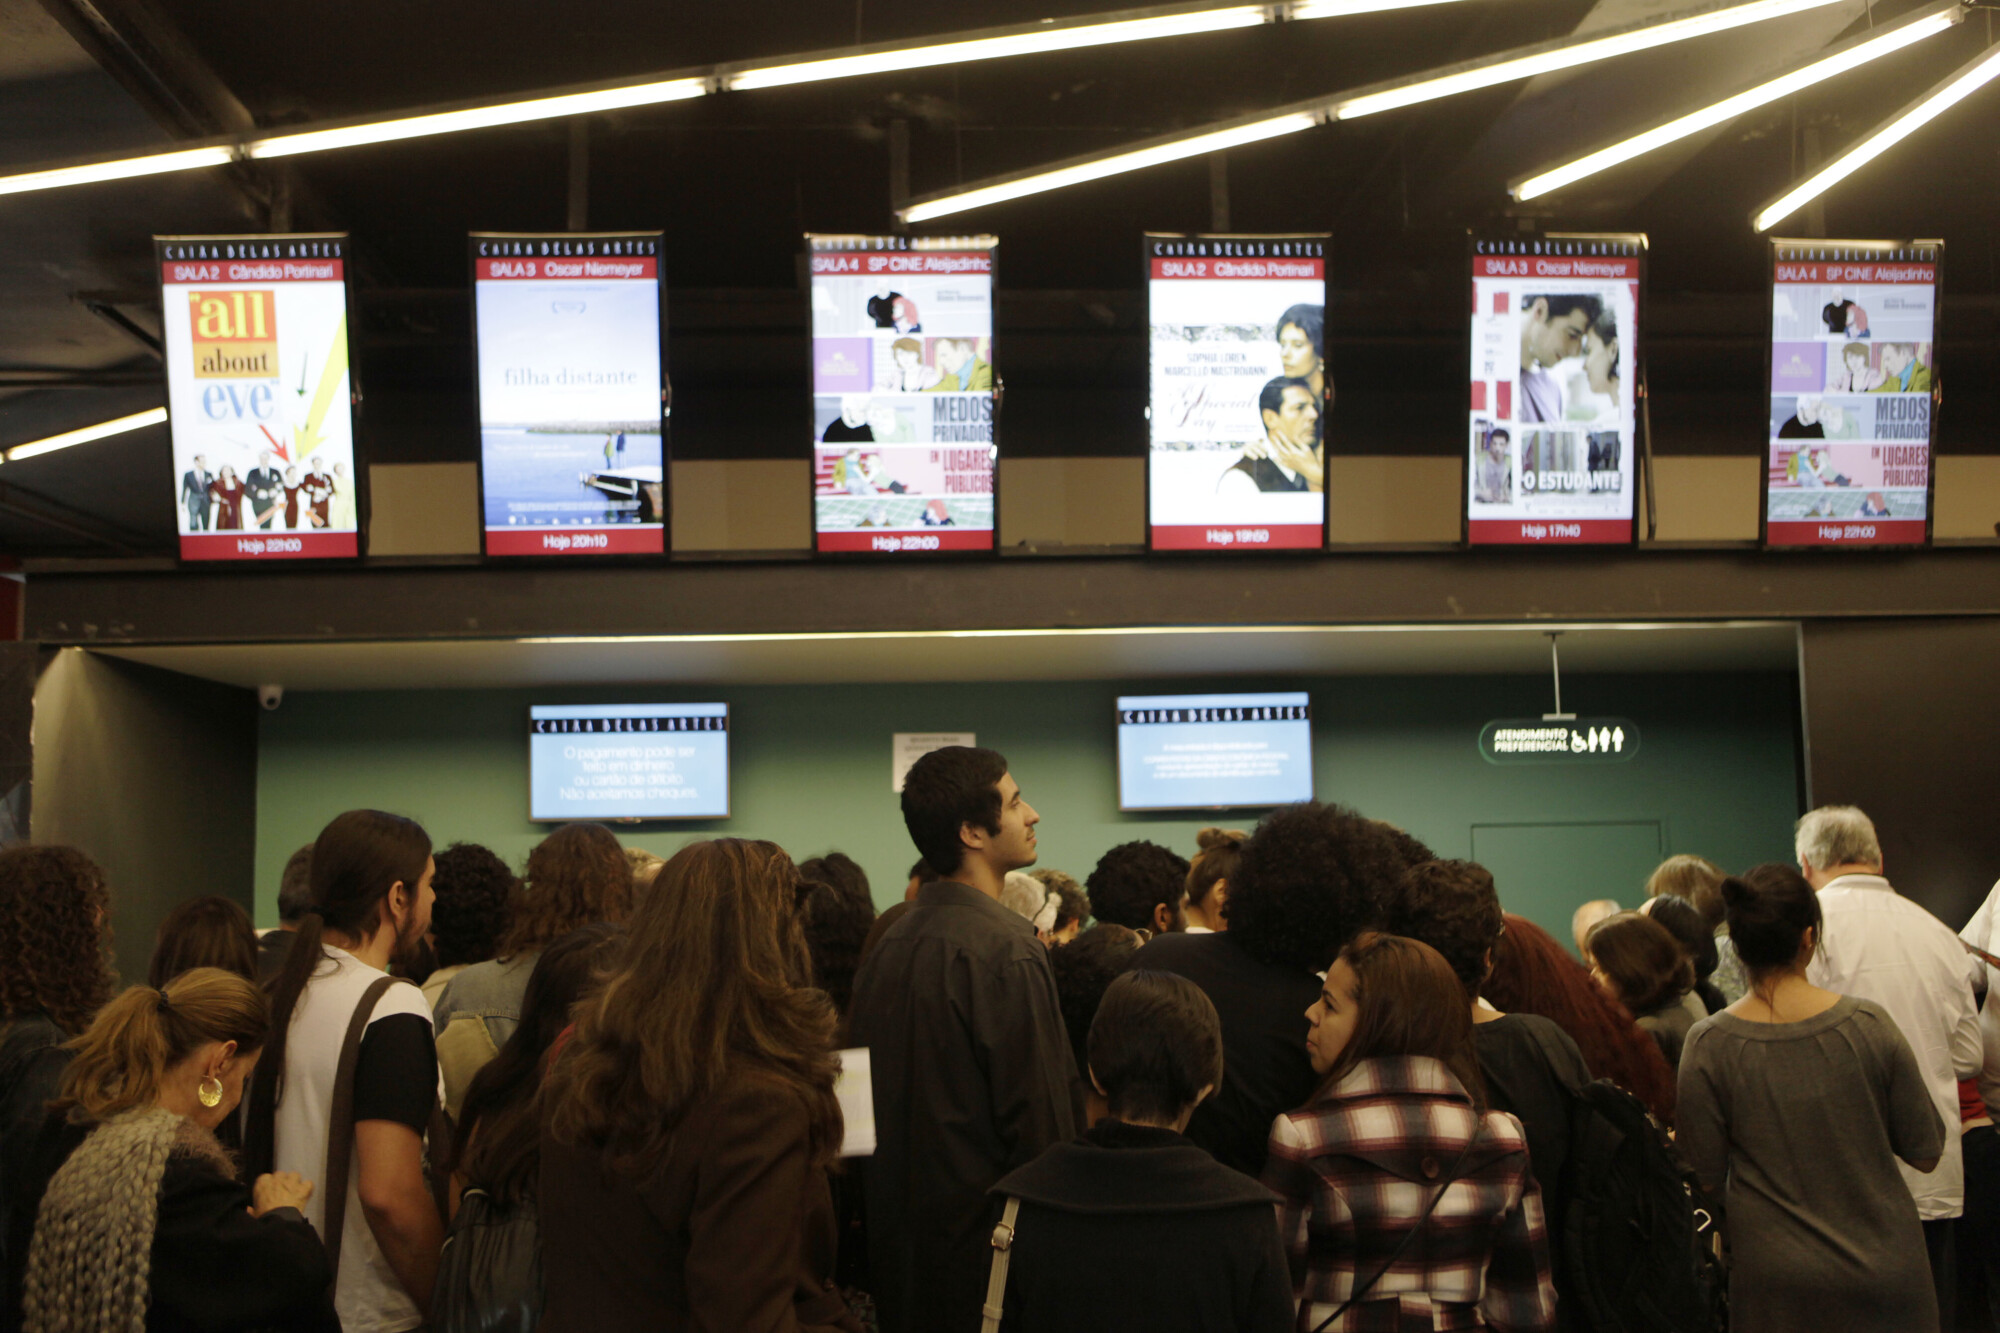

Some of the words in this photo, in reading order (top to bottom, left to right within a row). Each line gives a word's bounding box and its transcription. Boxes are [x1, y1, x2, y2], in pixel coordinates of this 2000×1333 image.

[165, 245, 219, 259] CAIXA
[289, 242, 340, 257] ARTES
[479, 242, 533, 256] CAIXA
[603, 241, 655, 255] ARTES
[1154, 242, 1206, 256] CAIXA
[1273, 242, 1322, 257] ARTES
[1477, 240, 1526, 254] CAIXA
[174, 265, 209, 281] SALA
[210, 266, 220, 280] 2
[284, 263, 333, 278] Portinari
[490, 262, 525, 277] SALA
[526, 262, 536, 277] 3
[544, 262, 583, 277] Oscar
[585, 262, 644, 278] Niemeyer
[812, 258, 848, 272] SALA
[849, 258, 859, 271] 4
[868, 257, 888, 271] SP
[889, 257, 923, 271] CINE
[1162, 262, 1196, 277] SALA
[1197, 262, 1206, 277] 2
[1267, 262, 1314, 277] Portinari
[1486, 260, 1518, 275] SALA
[1519, 260, 1528, 275] 3
[1536, 260, 1571, 275] Oscar
[1777, 266, 1808, 281] SALA
[1809, 267, 1817, 280] 4
[1827, 267, 1842, 280] SP
[1844, 266, 1873, 280] CINE
[202, 347, 269, 373] about
[1187, 353, 1217, 363] SOPHIA
[1221, 353, 1247, 362] LOREN
[504, 367, 550, 386] filha
[556, 367, 637, 385] distante
[1164, 366, 1208, 376] MARCELLO
[933, 397, 993, 421] MEDOS
[1876, 397, 1928, 421] MEDOS
[933, 425, 993, 442] PRIVADOS
[1875, 423, 1928, 440] PRIVADOS
[943, 450, 993, 472] LUGARES
[1883, 445, 1928, 467] LUGARES
[1524, 470, 1536, 490] O
[1538, 470, 1620, 490] ESTUDANTE
[1206, 529, 1233, 545] Hoje
[1522, 523, 1547, 540] Hoje
[1549, 524, 1580, 538] 17h40
[1819, 525, 1843, 541] Hoje
[237, 538, 265, 555] Hoje
[543, 534, 571, 551] Hoje
[572, 534, 608, 548] 20h10
[872, 536, 901, 552] Hoje
[1123, 710, 1181, 724] CAIXA
[1188, 708, 1244, 723] BELAS
[1251, 706, 1306, 721] ARTES
[536, 720, 593, 733] CAIXA
[602, 718, 659, 732] BELAS
[667, 717, 723, 731] ARTES
[1494, 728, 1568, 741] ATENDIMENTO
[564, 746, 576, 759] O
[645, 746, 675, 759] pode
[1494, 740, 1569, 752] PREFERENCIAL
[608, 761, 628, 772] em
[630, 760, 675, 772] dinheiro
[574, 776, 590, 787] ou
[630, 774, 645, 785] de
